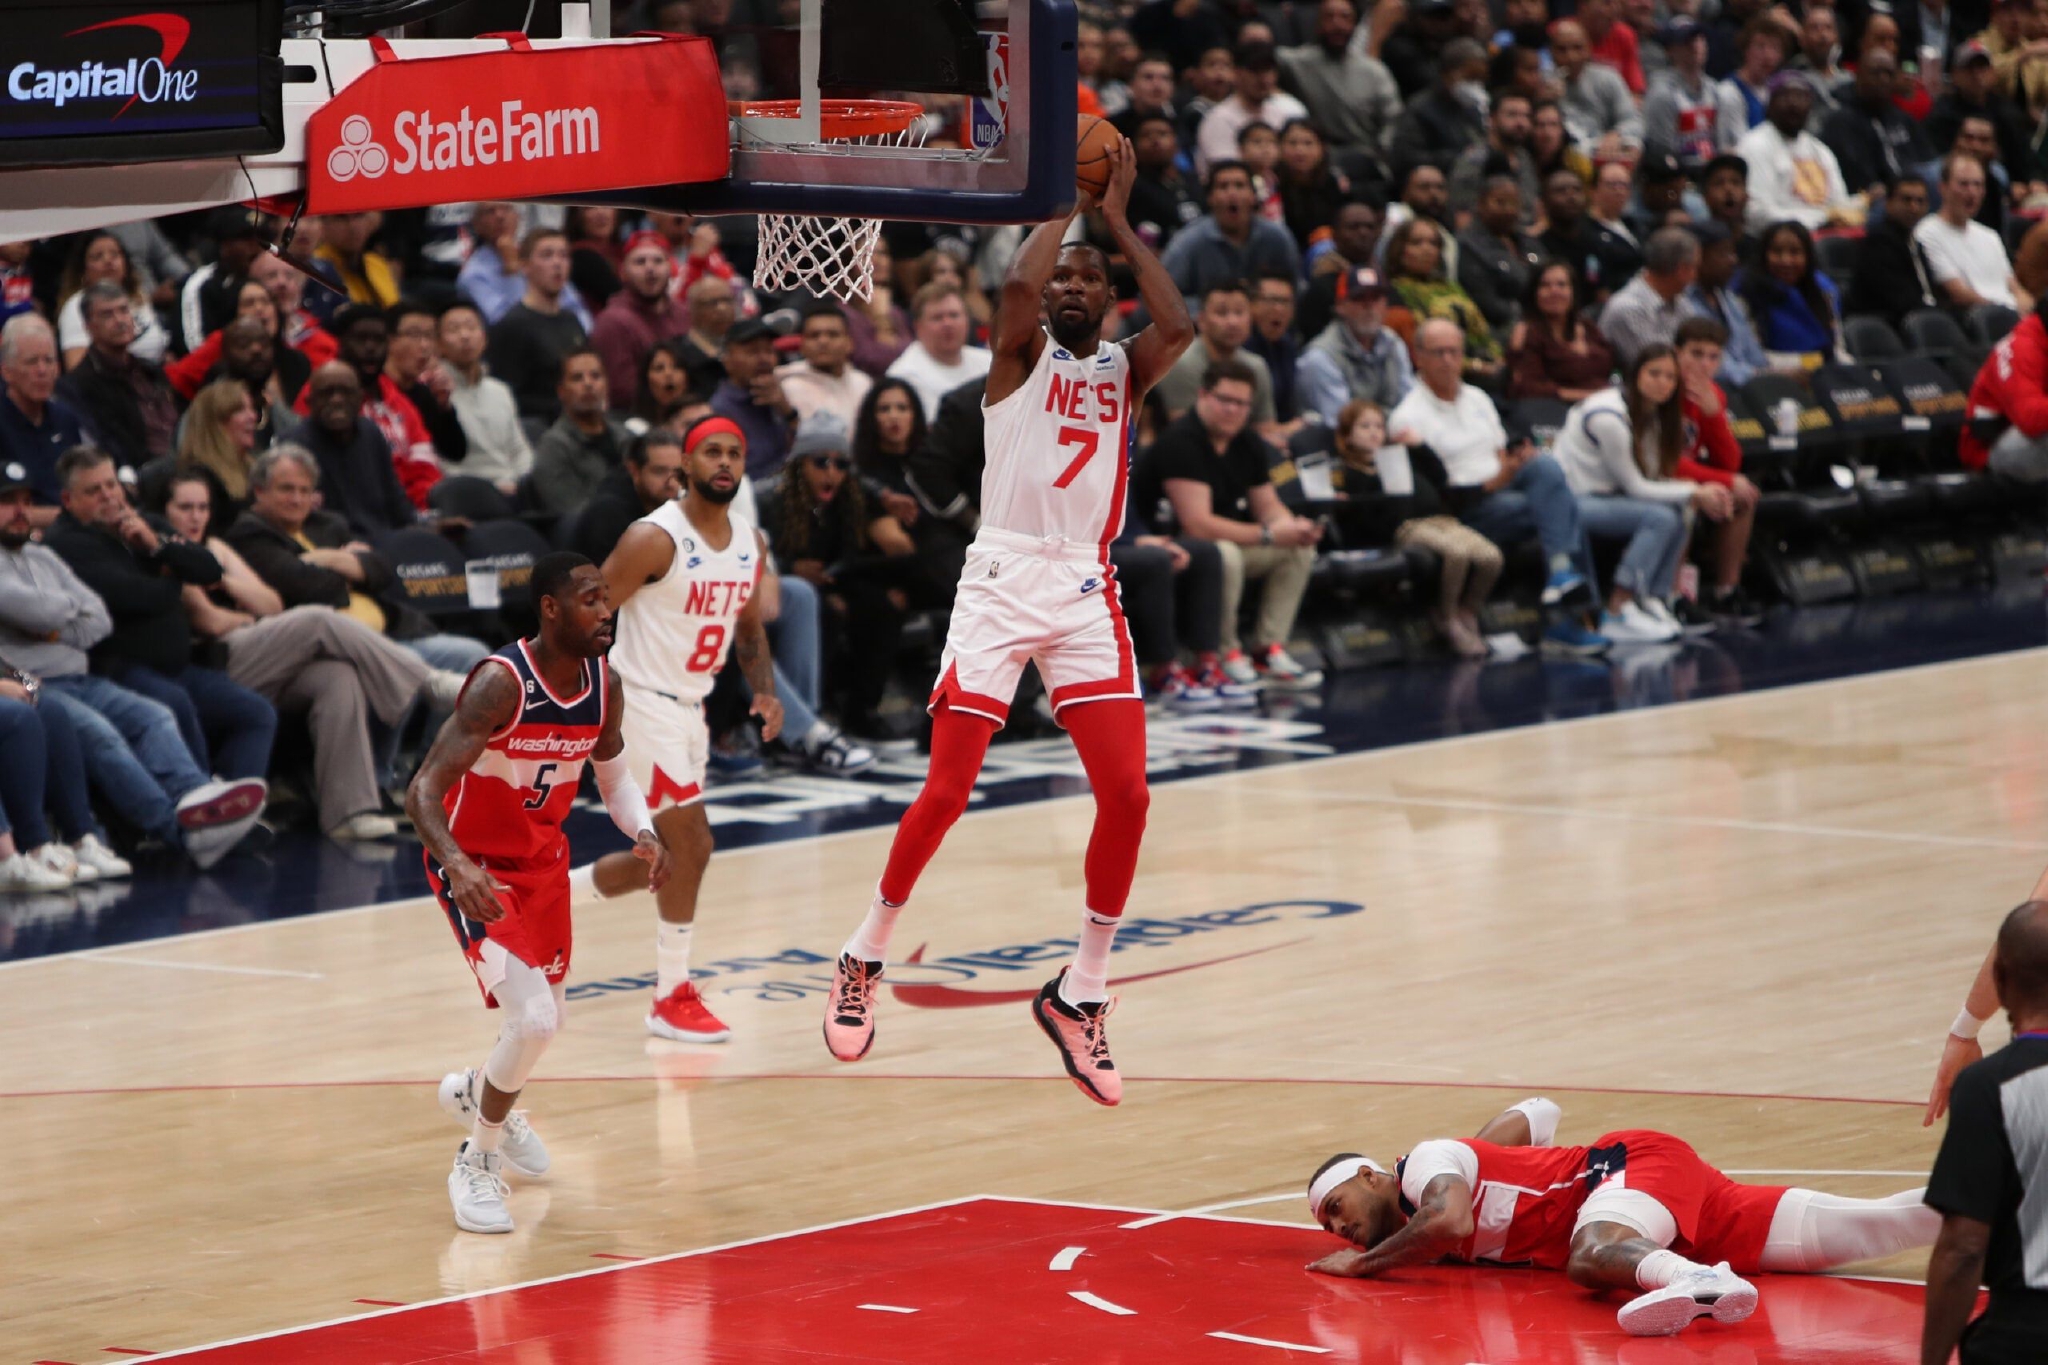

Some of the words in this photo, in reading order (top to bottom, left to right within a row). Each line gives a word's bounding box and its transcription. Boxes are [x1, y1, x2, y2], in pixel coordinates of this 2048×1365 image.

[1052, 425, 1100, 489] 7
[685, 624, 725, 673] 8
[526, 680, 535, 693] 6
[523, 763, 558, 810] 5
